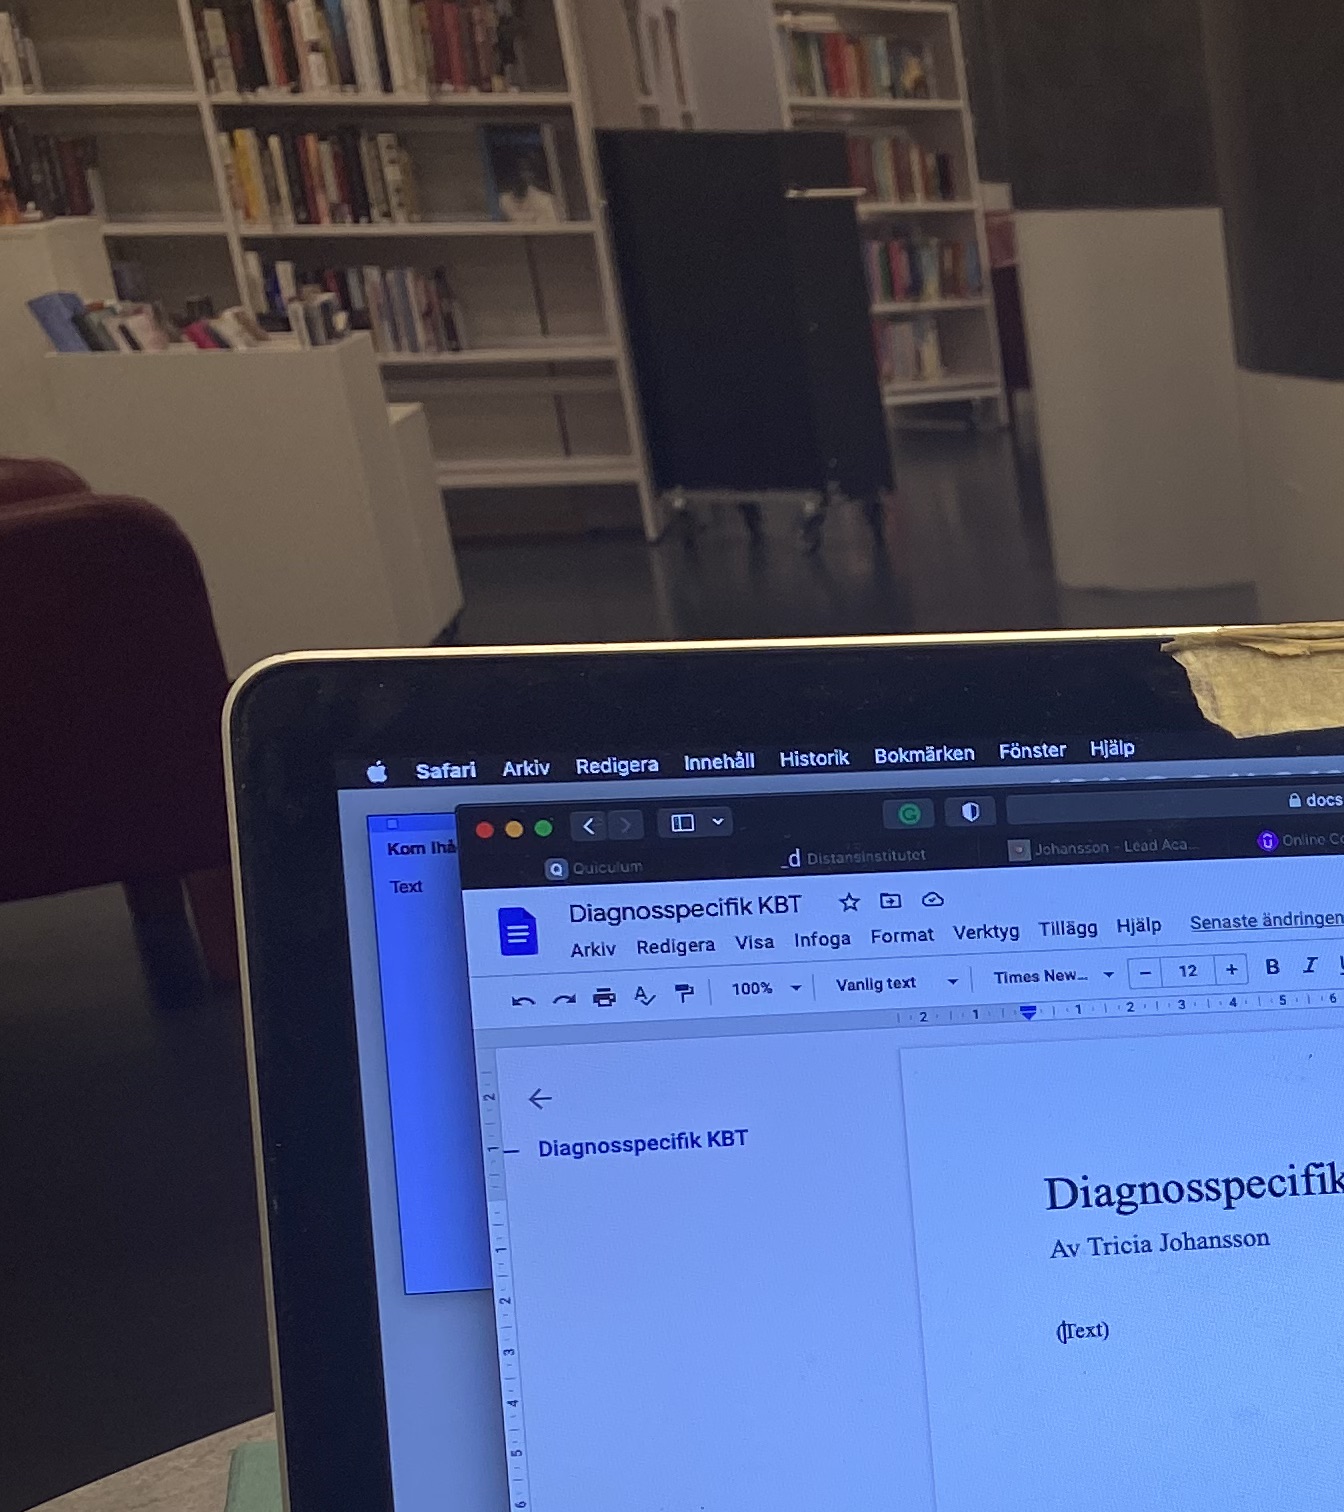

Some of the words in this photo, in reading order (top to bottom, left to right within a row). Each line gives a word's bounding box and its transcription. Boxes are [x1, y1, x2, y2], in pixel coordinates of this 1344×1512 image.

[416, 761, 476, 780] Safari
[502, 758, 551, 777] Arkiv
[576, 755, 659, 775] Redigera
[684, 751, 755, 772] Innehåll
[780, 748, 850, 768] Historik
[874, 743, 975, 764] Bokmärken
[999, 739, 1067, 761] Fönster
[1090, 737, 1135, 759] Hjälp
[388, 841, 425, 857] Kom
[1036, 839, 1108, 856] Johansson
[1123, 838, 1156, 854] Lead
[1281, 832, 1327, 848] Online
[808, 847, 926, 865] Distansinstitutet
[390, 879, 422, 894] Text
[570, 896, 752, 925] Diagnosspecifik
[758, 894, 801, 915] KBT
[1190, 914, 1258, 931] Senaste
[1262, 910, 1344, 928] ändringen
[571, 941, 616, 959] Arkiv
[637, 937, 715, 956] Redigera
[736, 933, 774, 950] Visa
[795, 930, 851, 949] Infoga
[871, 927, 934, 945] Format
[953, 922, 1019, 942] Verktyg
[1039, 919, 1098, 939] Tillägg
[1117, 917, 1161, 935] Hjälp
[732, 981, 772, 996] 100%
[836, 976, 882, 994] Vanlig
[888, 974, 916, 989] text
[993, 970, 1039, 986] Times
[1179, 964, 1197, 978] 12
[539, 1132, 701, 1158] Diagnosspecifik
[707, 1129, 748, 1147] KBT
[1050, 1239, 1080, 1259] Av
[1088, 1234, 1153, 1257] Tricia
[1160, 1229, 1270, 1253] Johansson
